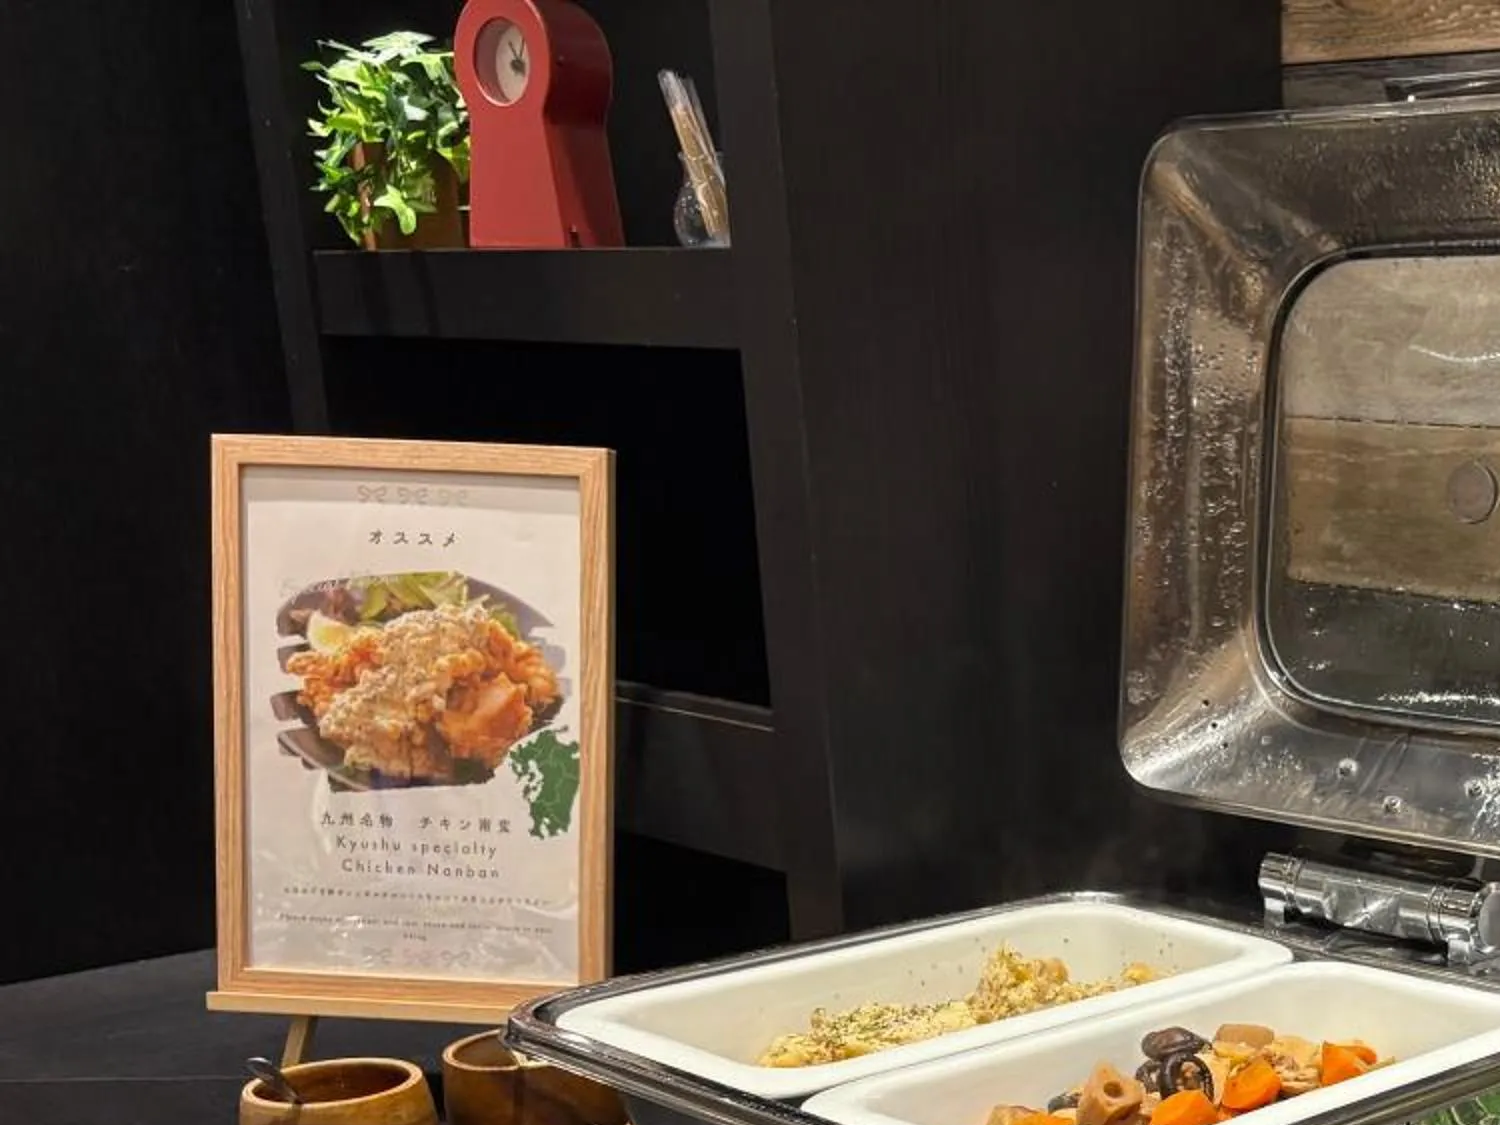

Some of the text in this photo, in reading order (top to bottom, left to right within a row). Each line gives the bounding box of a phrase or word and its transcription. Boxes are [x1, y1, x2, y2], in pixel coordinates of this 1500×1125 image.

[369, 529, 457, 547] オススメ
[320, 811, 512, 834] 九州名物 チキン南蛮
[335, 835, 498, 859] Kyushu specialty
[341, 858, 500, 879] Chicken Nanban
